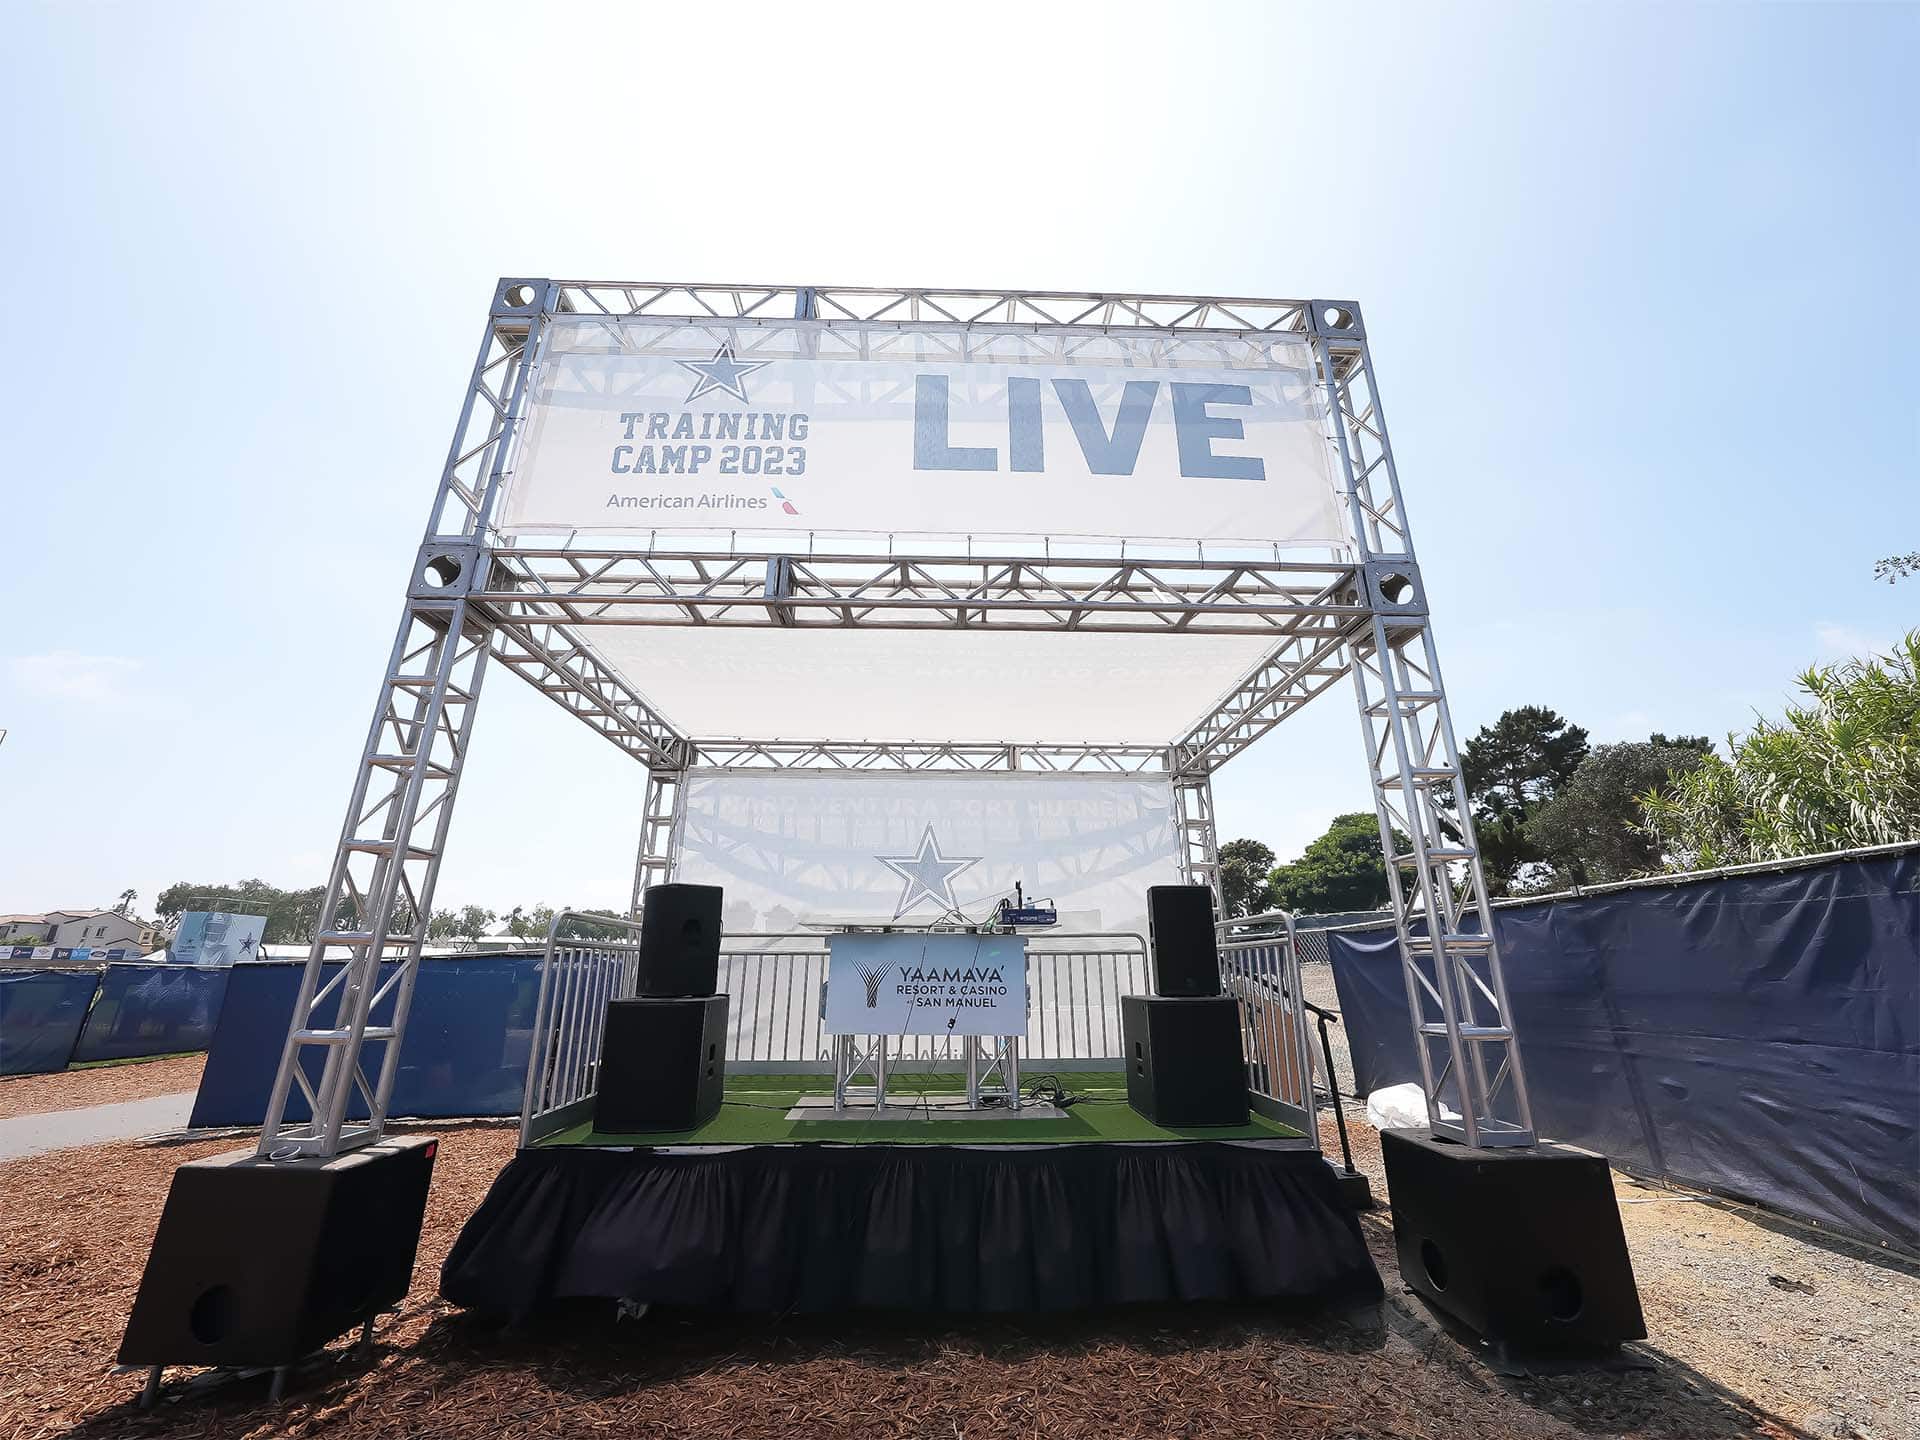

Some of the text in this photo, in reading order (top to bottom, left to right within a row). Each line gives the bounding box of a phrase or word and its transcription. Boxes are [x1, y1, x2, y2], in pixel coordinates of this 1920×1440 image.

[620, 412, 809, 441] TRAINING
[913, 374, 1266, 481] LIVE
[611, 445, 806, 476] CAMP 2023
[606, 494, 768, 509] American Airlines
[896, 985, 1007, 996] RESORT & CASINO
[916, 998, 941, 1007] SAN
[946, 998, 997, 1008] MANUEL
